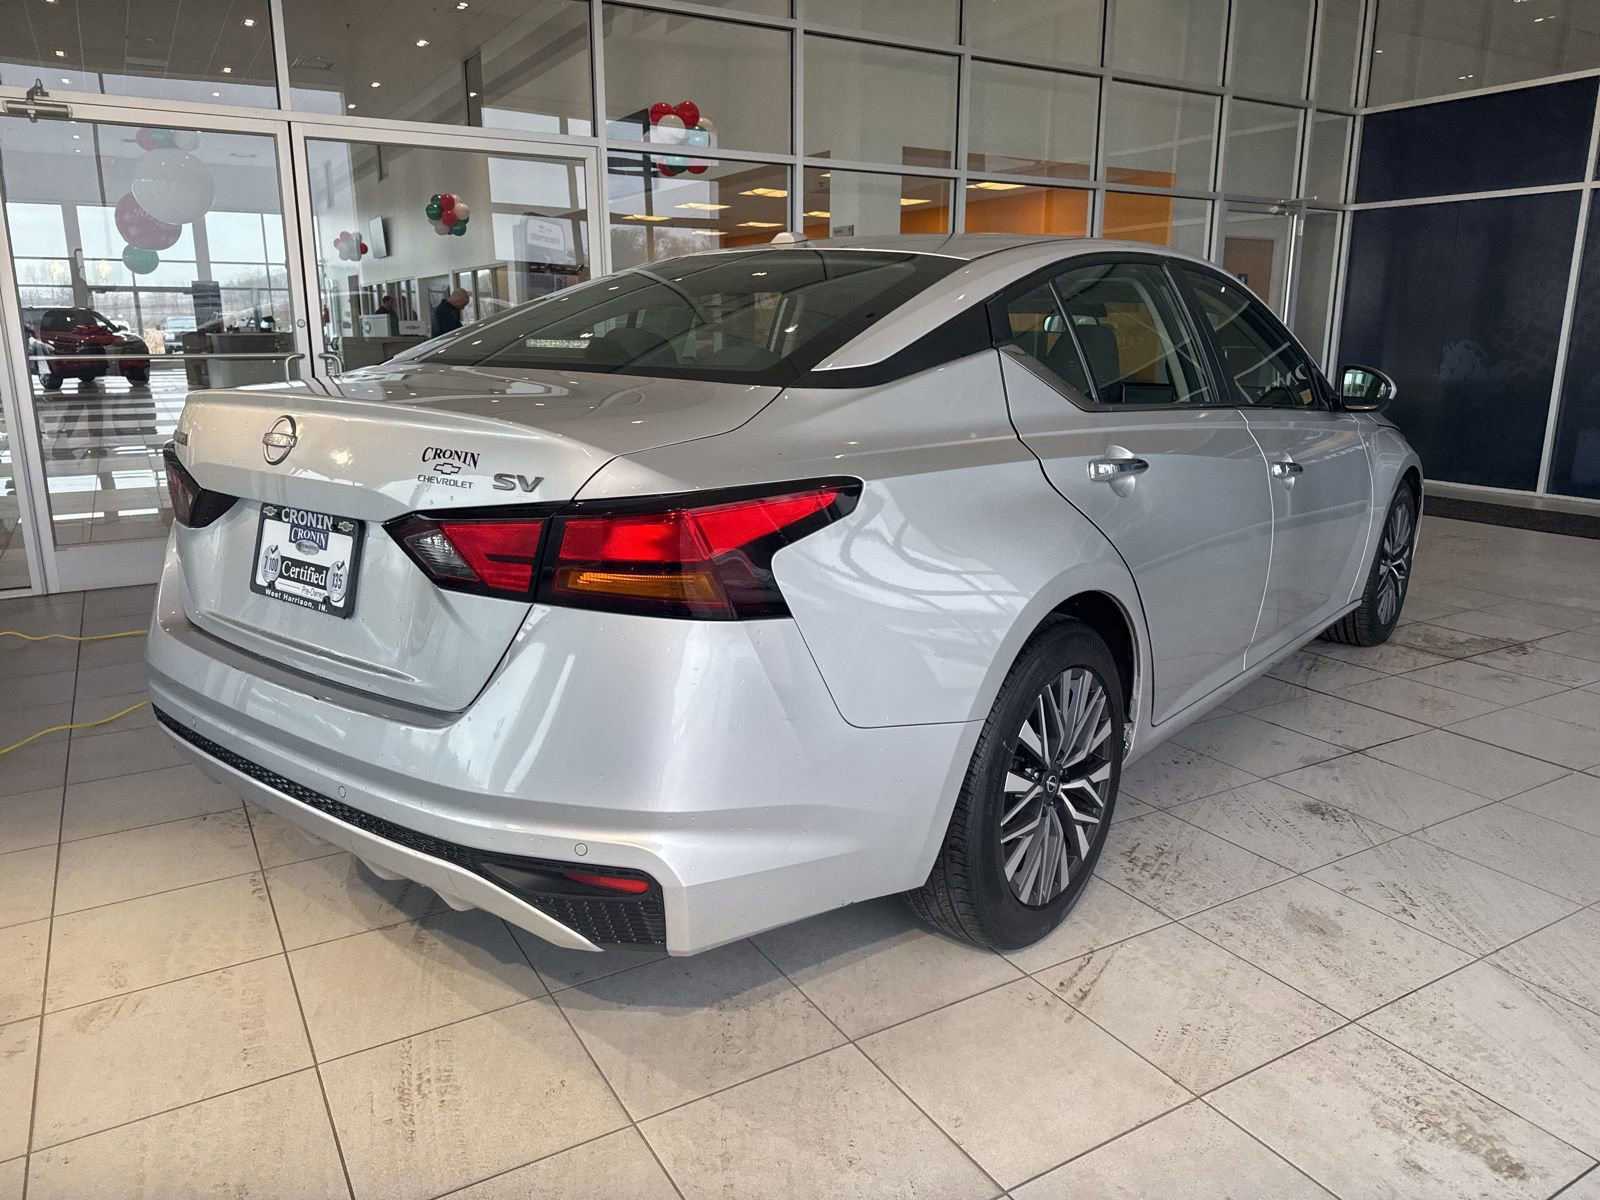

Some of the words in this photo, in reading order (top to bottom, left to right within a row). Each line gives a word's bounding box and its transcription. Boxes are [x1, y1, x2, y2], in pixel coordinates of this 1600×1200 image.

[421, 446, 480, 469] CRONIN
[417, 474, 474, 489] CHEVROLET
[492, 473, 544, 493] SV
[281, 507, 334, 531] CRONIN
[291, 527, 328, 549] CRONIN
[282, 560, 326, 585] Certified
[332, 572, 343, 591] 135
[265, 588, 281, 598] West
[283, 593, 315, 608] Harrison,
